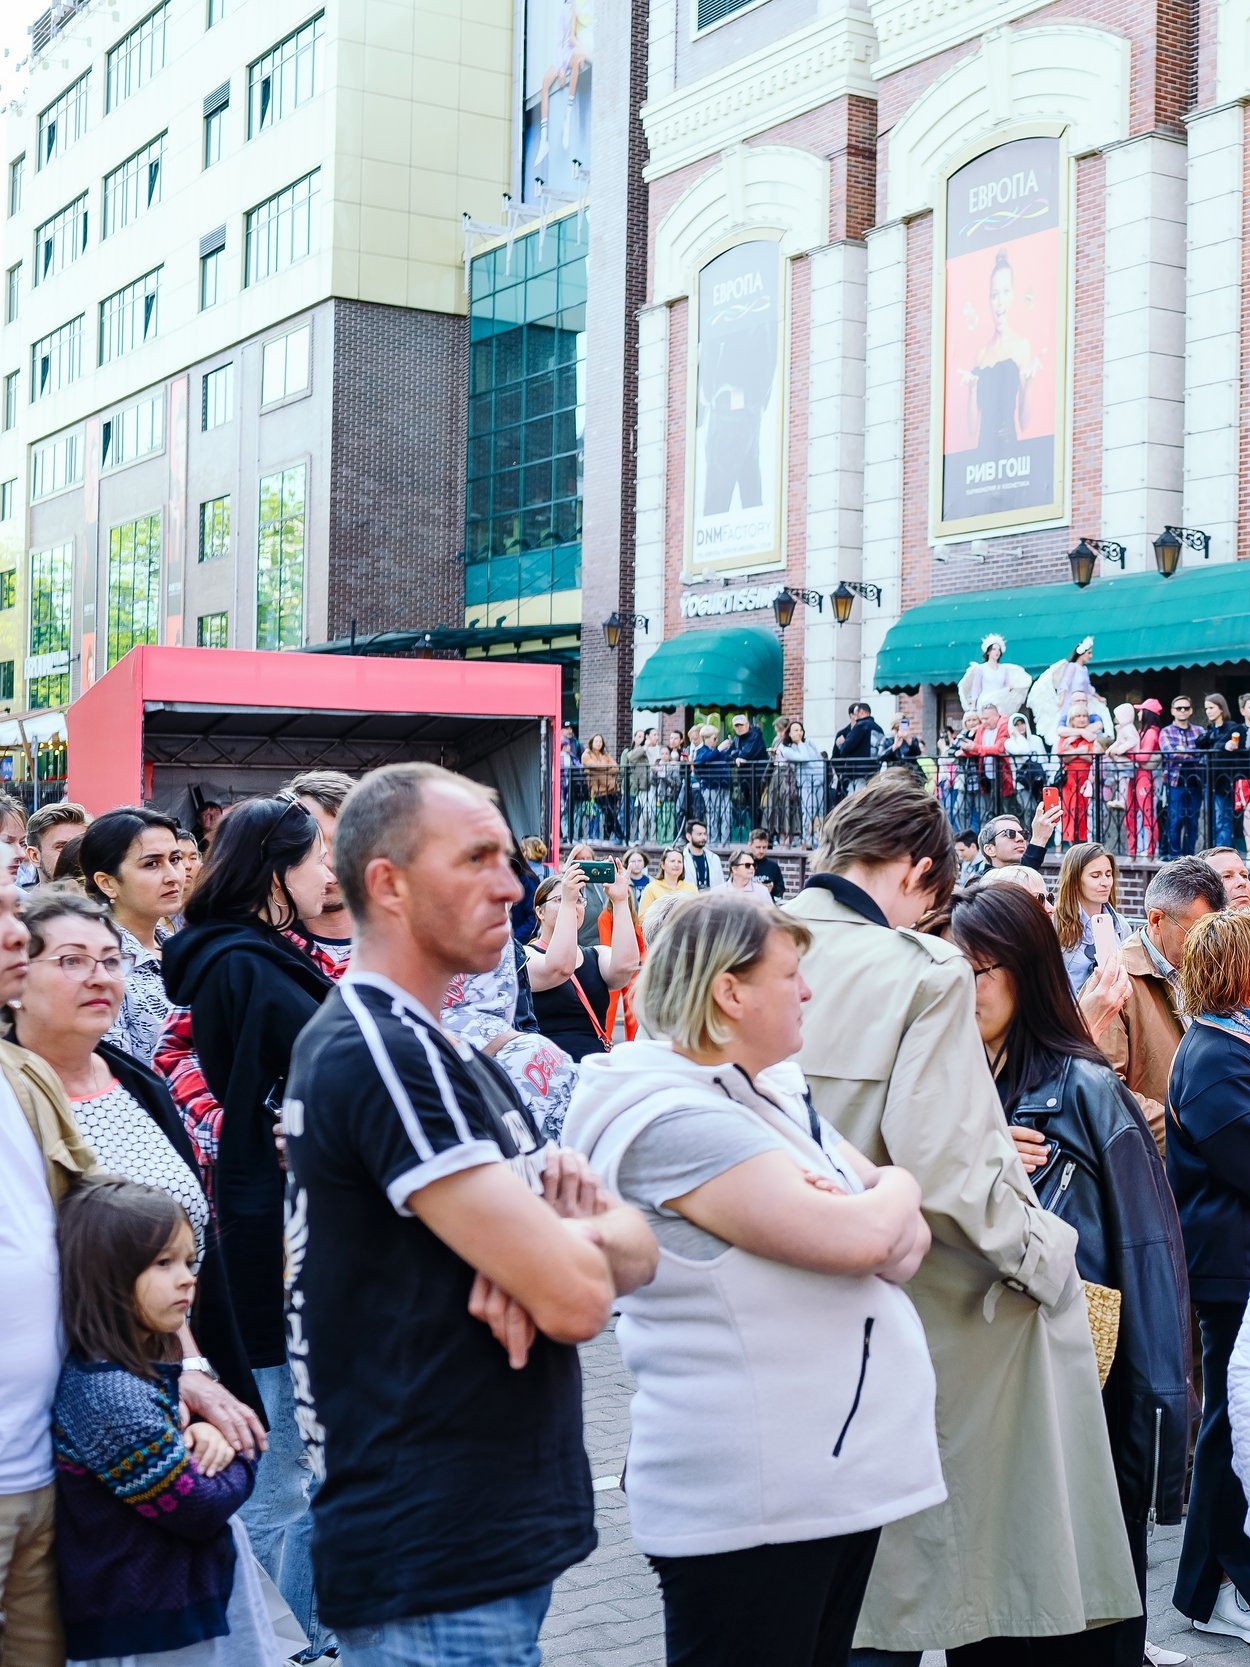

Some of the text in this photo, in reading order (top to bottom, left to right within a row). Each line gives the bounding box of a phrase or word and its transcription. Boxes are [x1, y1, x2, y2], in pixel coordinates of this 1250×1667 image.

[968, 169, 1039, 214] ЕВРОПА
[713, 271, 764, 306] ЕВРОПА
[966, 455, 1031, 485] РИВ ГОШ
